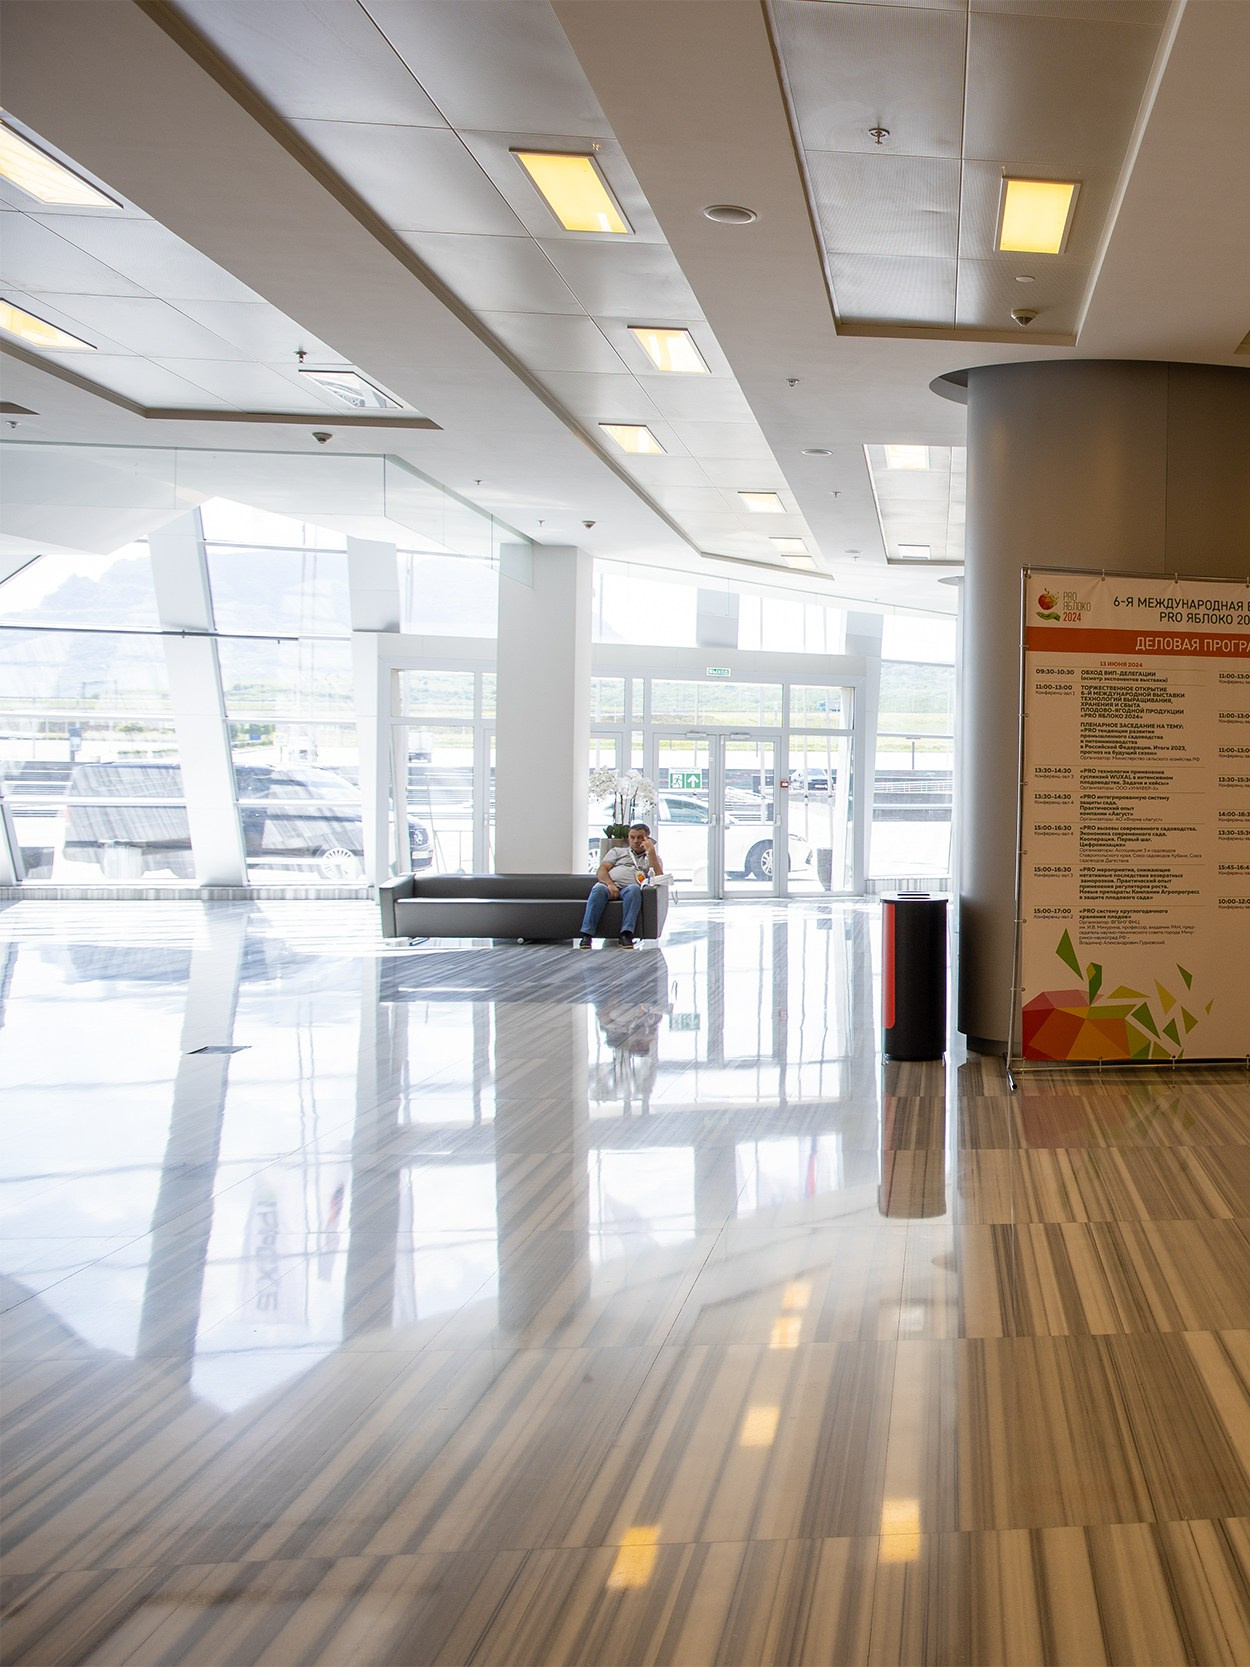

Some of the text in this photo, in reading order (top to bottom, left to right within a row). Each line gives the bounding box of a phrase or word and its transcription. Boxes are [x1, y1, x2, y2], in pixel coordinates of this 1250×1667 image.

[1062, 602, 1092, 611] ЯБЛОКО
[1114, 596, 1134, 607] 6-Я
[1138, 598, 1244, 612] МЕЖДУНАРОДНАЯ
[1062, 612, 1082, 622] 2024
[1160, 612, 1182, 622] PRO
[1186, 613, 1233, 624] ЯБЛОКО
[1136, 637, 1200, 650] ДЕЛОВАЯ
[1093, 690, 1152, 698] МЕЖДУНАРОДНОЙ
[1080, 706, 1145, 714] ПЛОДОВО-ЯГОДНОЙ
